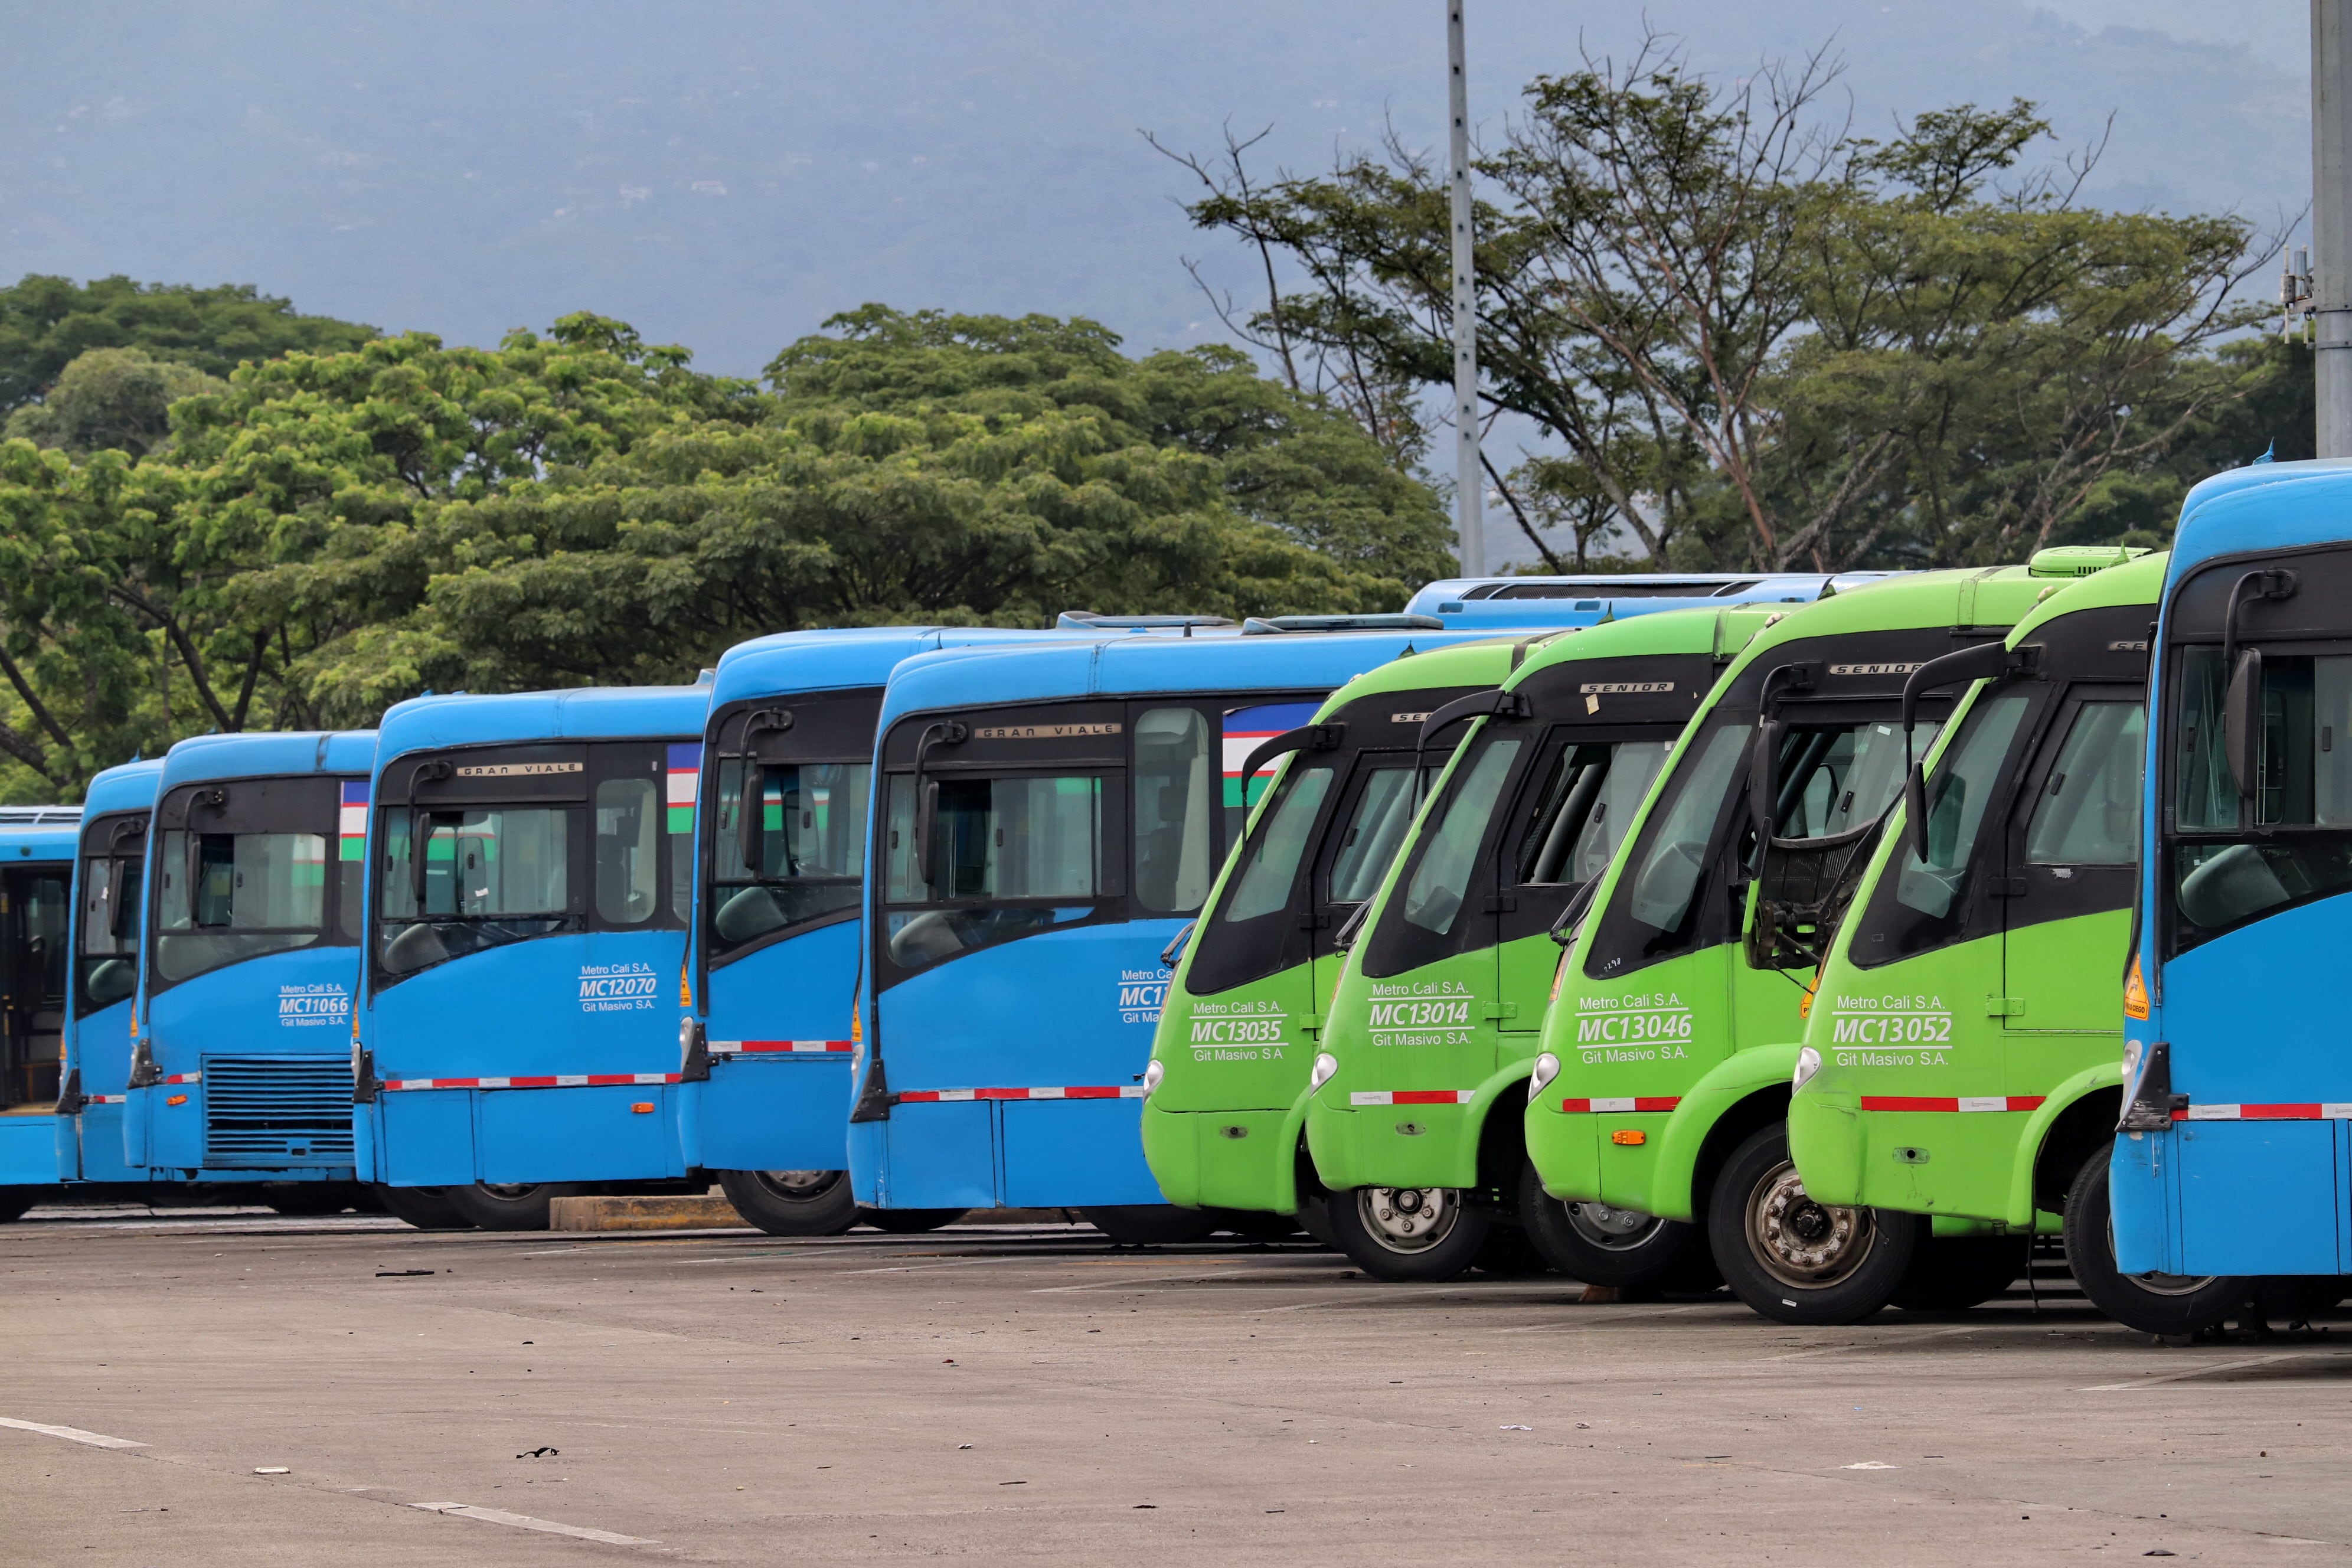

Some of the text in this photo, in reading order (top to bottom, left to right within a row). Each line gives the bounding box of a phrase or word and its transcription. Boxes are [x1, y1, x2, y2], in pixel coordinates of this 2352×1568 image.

[1587, 684, 1668, 692] SENIOR
[984, 725, 1113, 737] GRAN VIALE
[465, 763, 575, 775] GRAN VIALE
[582, 963, 652, 975] Metro Cali S.A.
[1122, 970, 1154, 981] Metro
[280, 984, 344, 994] Metro Cali S.A.
[580, 978, 656, 997] MC12070
[1373, 981, 1469, 996] Metro Cali S.A.
[1119, 986, 1168, 1006] MC1
[1580, 992, 1683, 1010] Metro Cali S.A.
[1837, 995, 1945, 1009] Metro Cali S.A.
[279, 997, 348, 1013] MC11066
[582, 999, 655, 1012] Git Masivo S.A.
[1194, 1001, 1282, 1014] Metro Cali S.A.
[1123, 1012, 1139, 1023] Git
[1369, 1002, 1469, 1025] MC13014
[281, 1016, 346, 1027] Git Masivo S.A.
[1577, 1014, 1693, 1042] MC13046
[1191, 1020, 1282, 1042] MC13035
[1832, 1017, 1952, 1043] MC13052
[1373, 1032, 1472, 1046] Git Masivo S.A.
[1194, 1050, 1211, 1061] Git
[1215, 1048, 1257, 1061] Masivo
[1582, 1046, 1688, 1064] Git Masivo S.A.
[1837, 1051, 1949, 1066] Git Masivo S.A.
